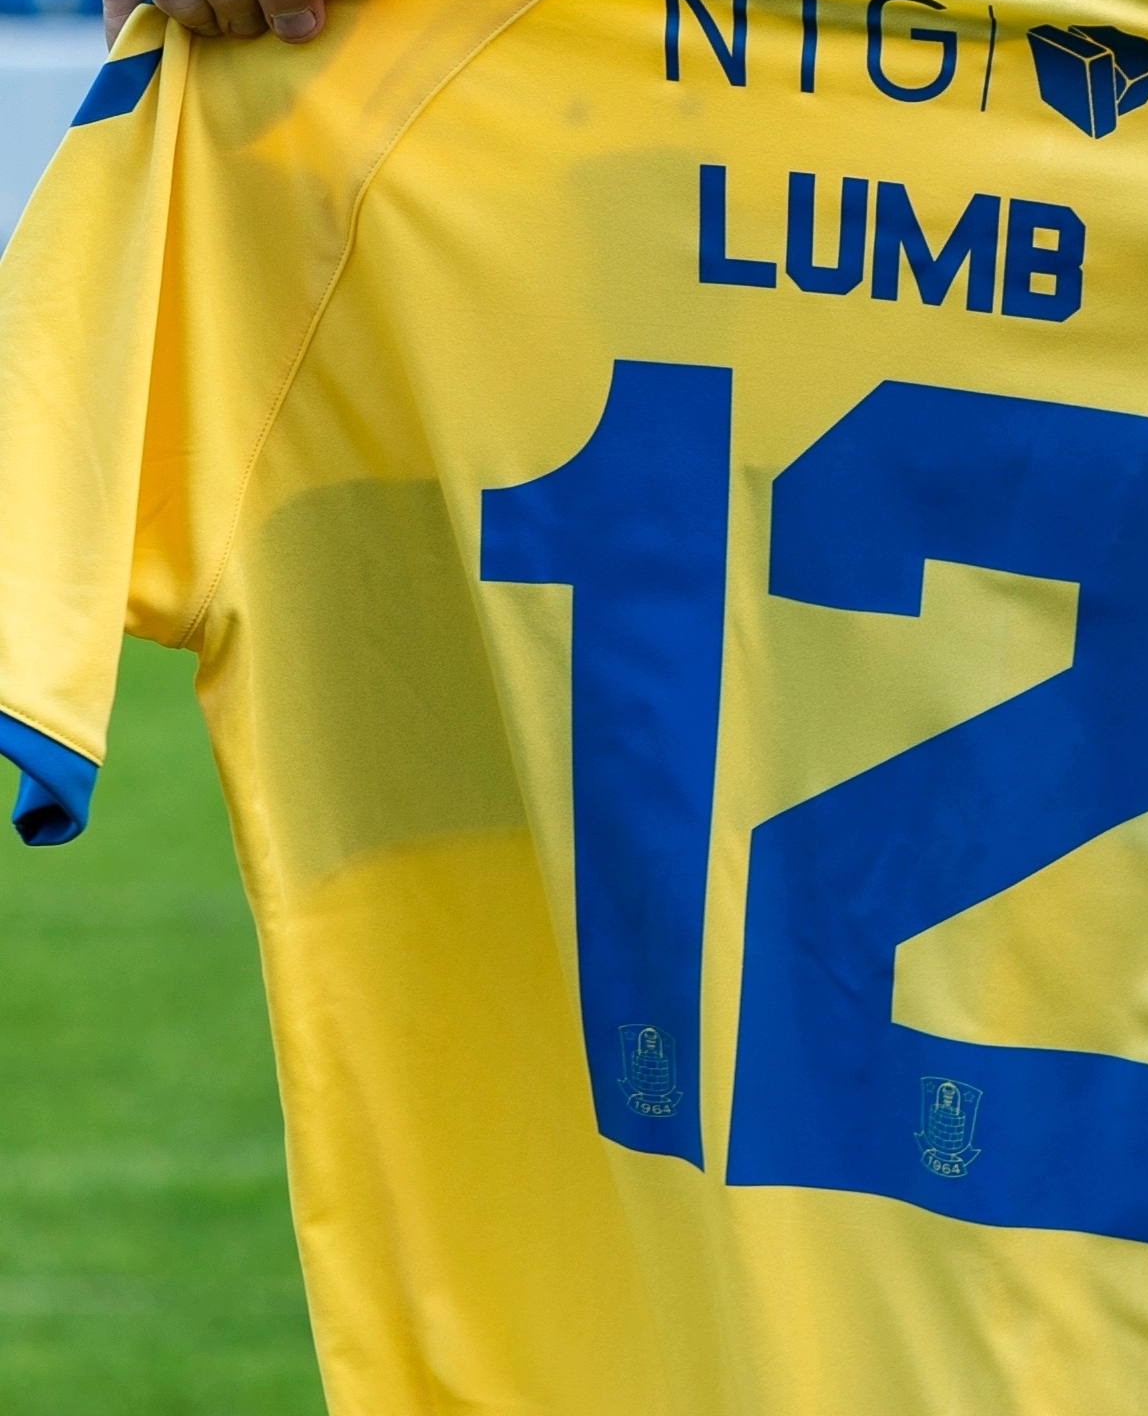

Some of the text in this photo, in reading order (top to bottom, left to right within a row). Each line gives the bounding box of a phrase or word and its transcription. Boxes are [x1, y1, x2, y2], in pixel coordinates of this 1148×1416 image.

[699, 163, 1087, 323] LUMB
[634, 1100, 672, 1115] 1964
[927, 1155, 962, 1175] 1964
